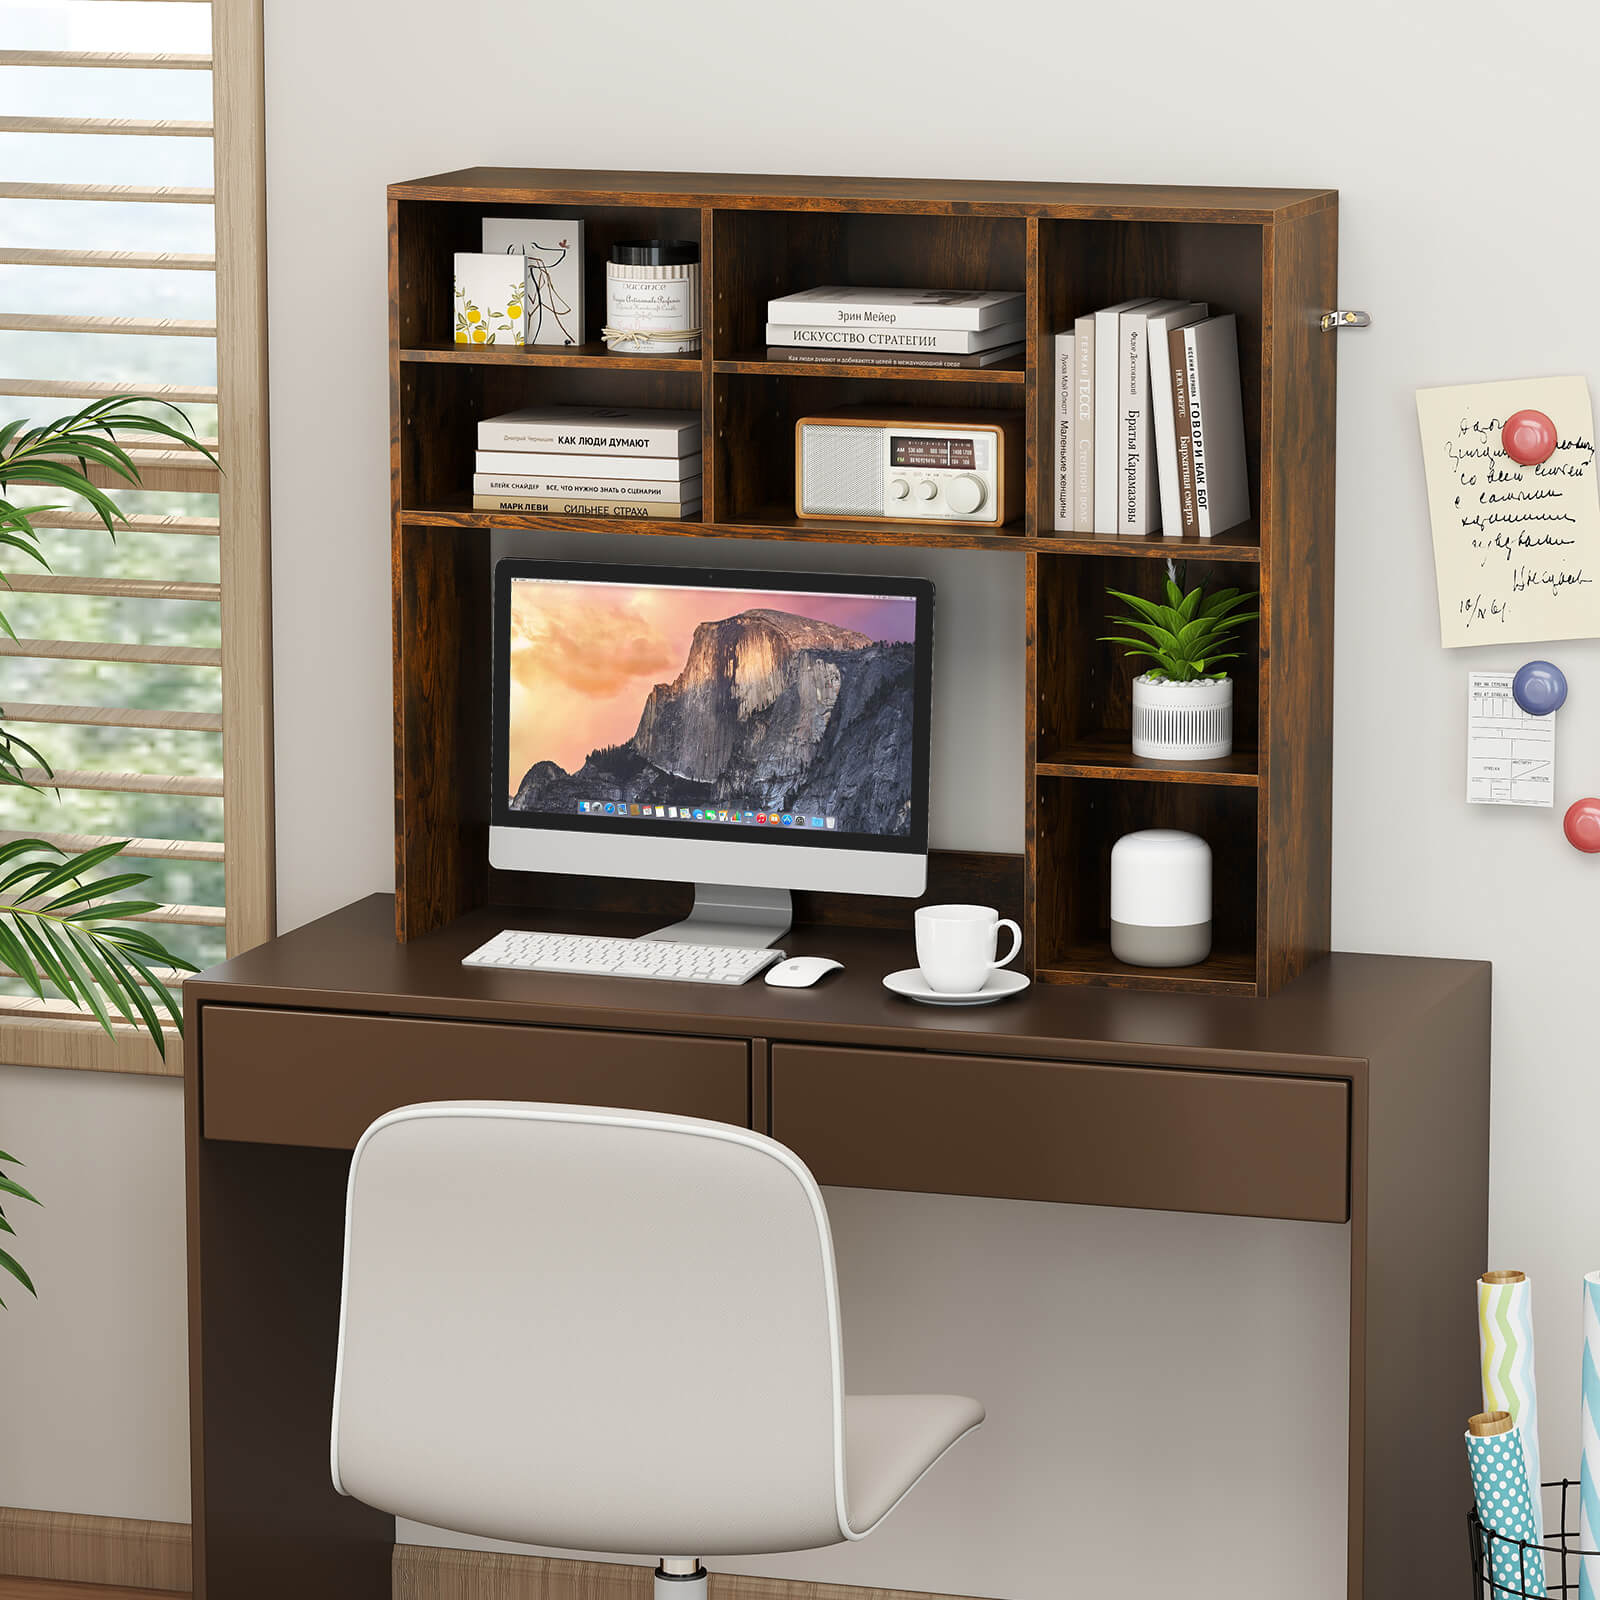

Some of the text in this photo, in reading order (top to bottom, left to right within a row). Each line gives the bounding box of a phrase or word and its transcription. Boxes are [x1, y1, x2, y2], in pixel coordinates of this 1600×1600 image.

[837, 310, 896, 324] Эрин Мейер
[793, 330, 937, 347] ИСКУССТВО СТРАТЕГИИ
[1061, 353, 1069, 374] Луиза
[1130, 352, 1138, 395] Достоевский
[1060, 391, 1068, 415] Олкотт
[1080, 378, 1090, 421] ГЕССЕ
[558, 436, 576, 445] КАК
[578, 437, 607, 447] ЛЮДИ
[608, 437, 650, 448] ДУМАЮТ
[1125, 409, 1140, 523] Братья Карамазовы
[1190, 402, 1207, 510] ГОВОРИ КАК БОГ
[1059, 420, 1068, 518] Маленькие женщины
[1178, 436, 1193, 525] Бархатная смерть
[490, 481, 510, 489] БЛЕЙК
[511, 482, 540, 490] СНАЙДЕР
[546, 484, 559, 492] ВСЕ,
[560, 484, 573, 492] ЧТО
[574, 485, 599, 493] НУЖНО
[600, 486, 619, 494] ЗНАТЬ
[627, 488, 662, 496] СЦЕНАРИИ
[500, 502, 649, 516] МАРК ЛЕВИ СИЛЬНЕЕ СТРАХА
